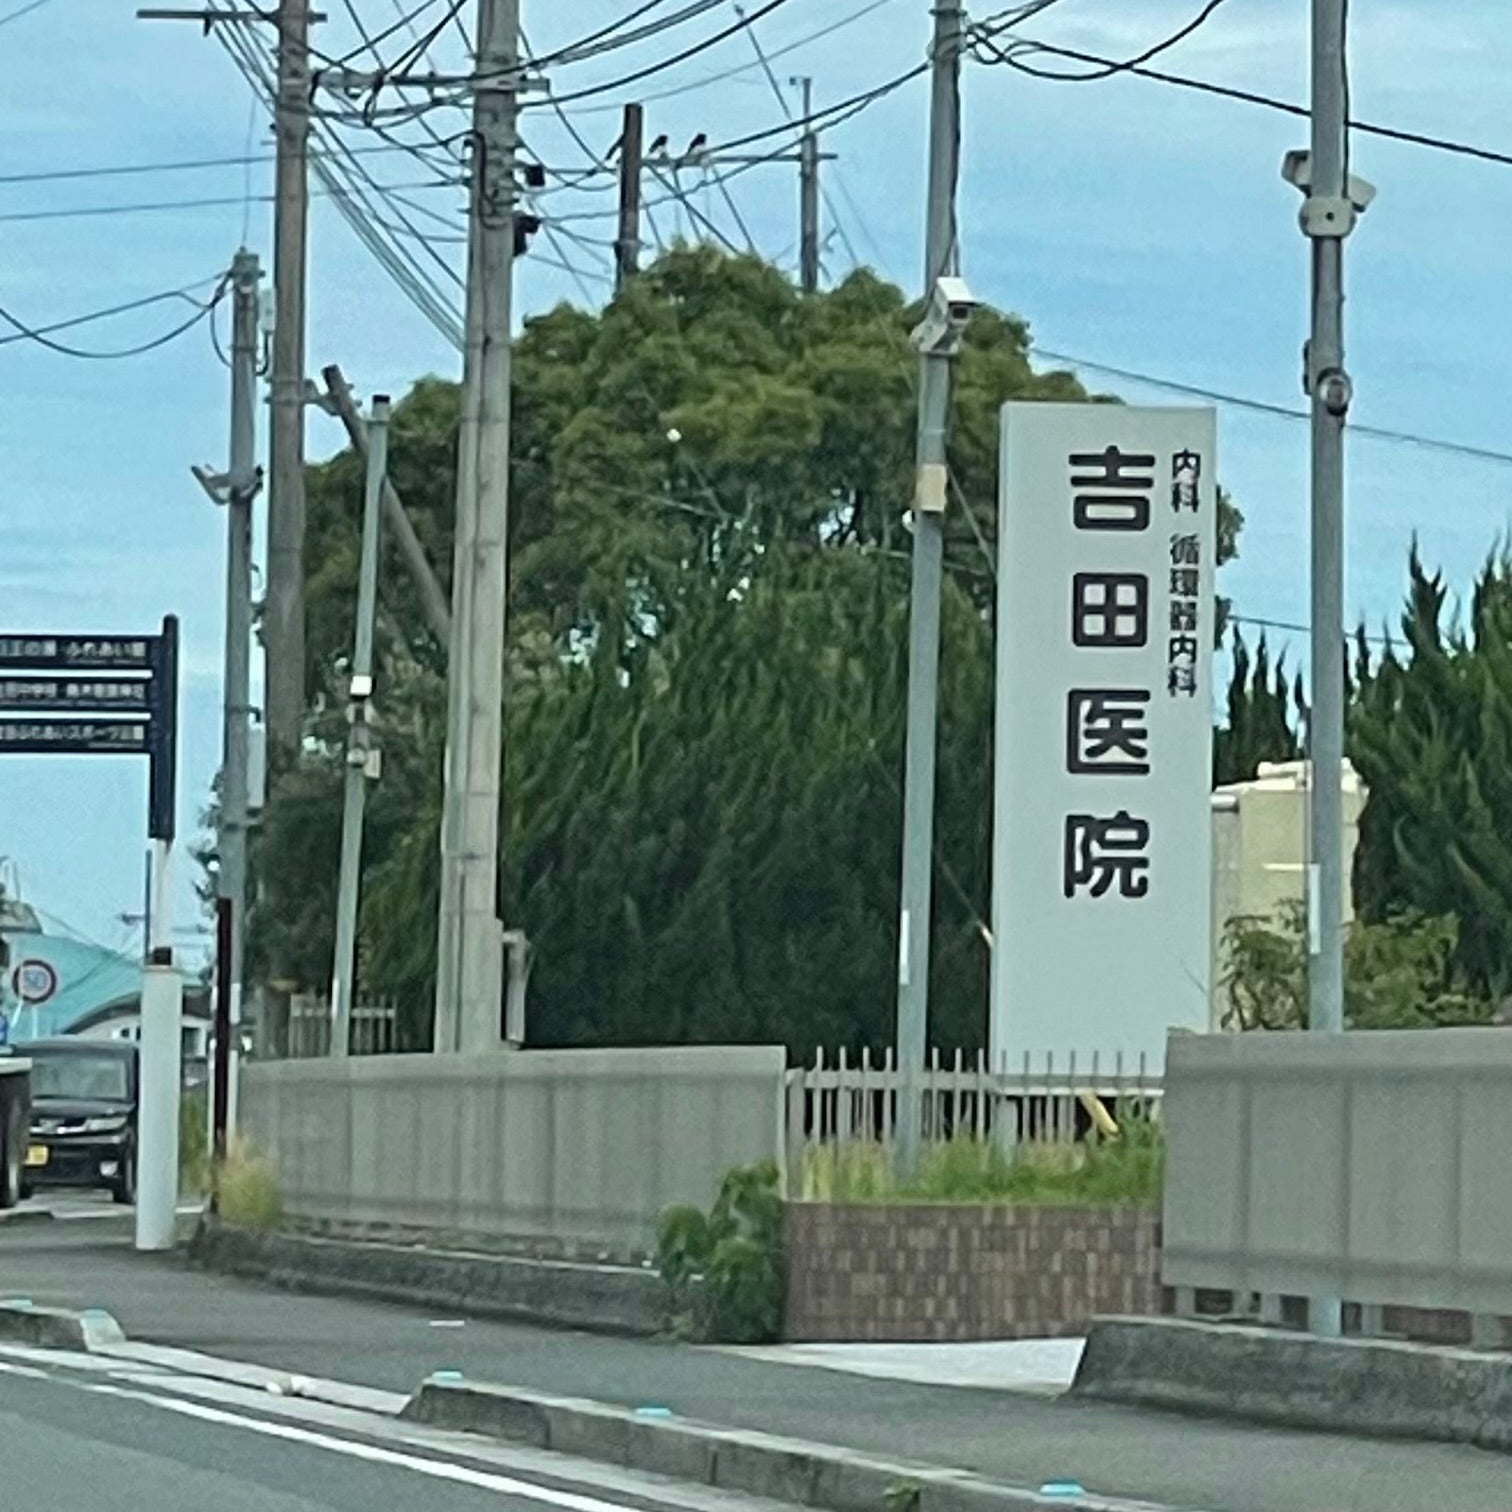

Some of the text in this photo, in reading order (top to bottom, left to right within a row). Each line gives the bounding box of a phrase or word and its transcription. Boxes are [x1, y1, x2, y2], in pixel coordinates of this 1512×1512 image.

[1171, 448, 1201, 514] 内科
[1063, 444, 1156, 899] 吉田医院
